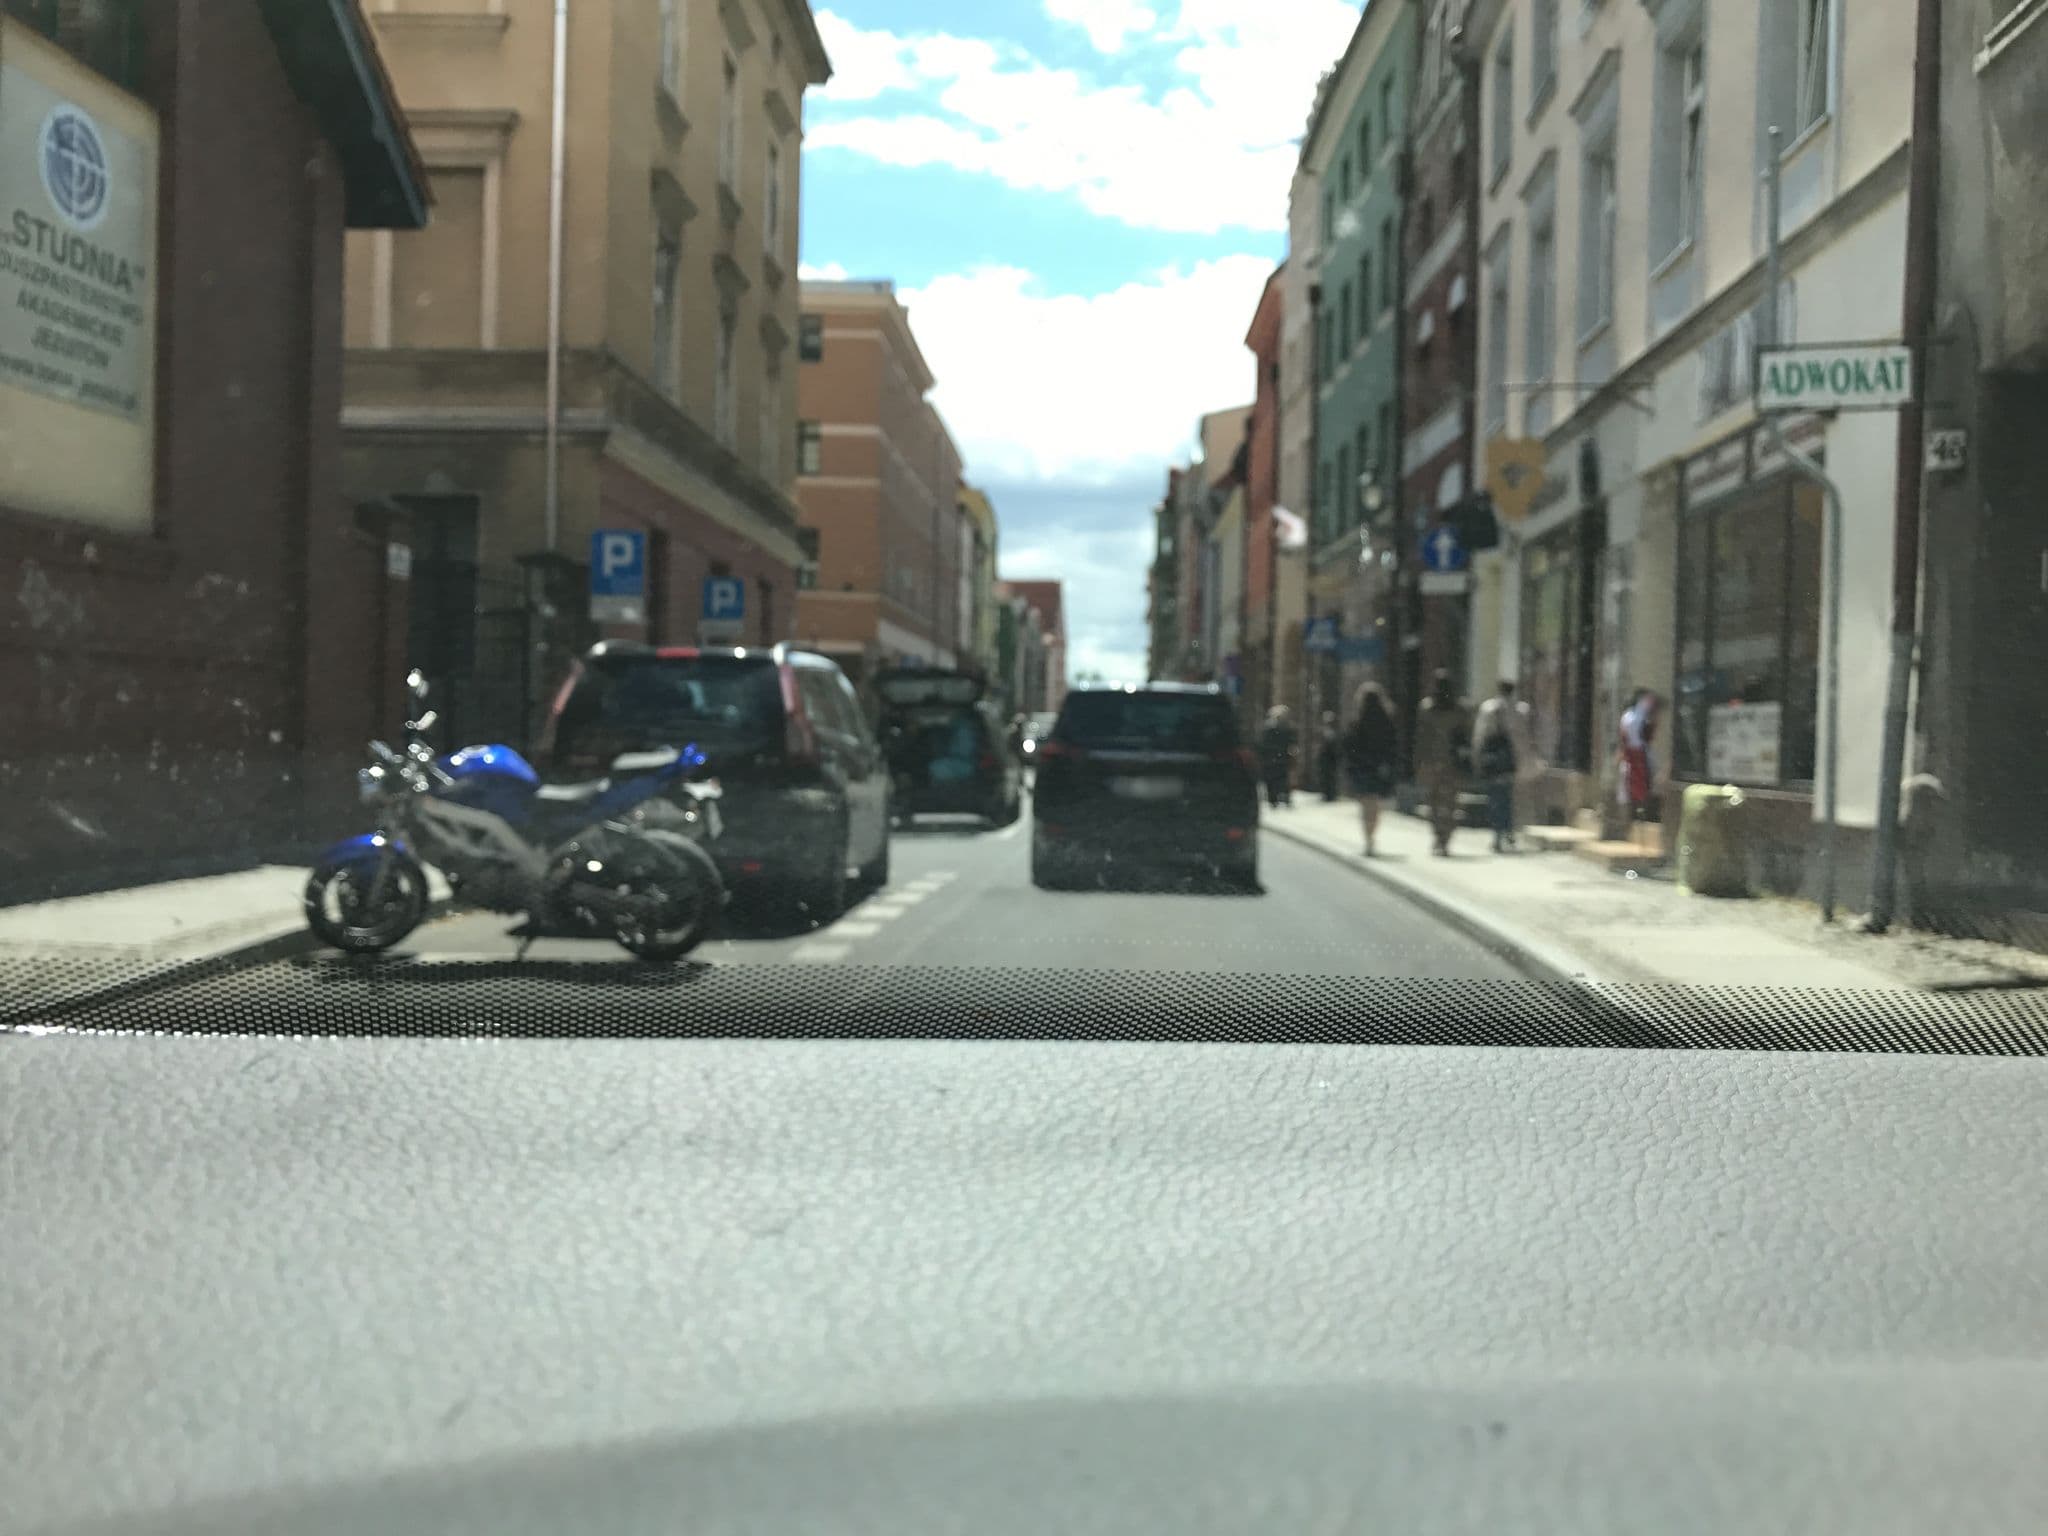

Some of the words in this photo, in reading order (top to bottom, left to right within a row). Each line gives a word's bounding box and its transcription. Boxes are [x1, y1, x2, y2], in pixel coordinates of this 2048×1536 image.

[1767, 357, 1906, 395] ADWOKAT
[602, 533, 635, 577] P
[710, 580, 737, 616] P
